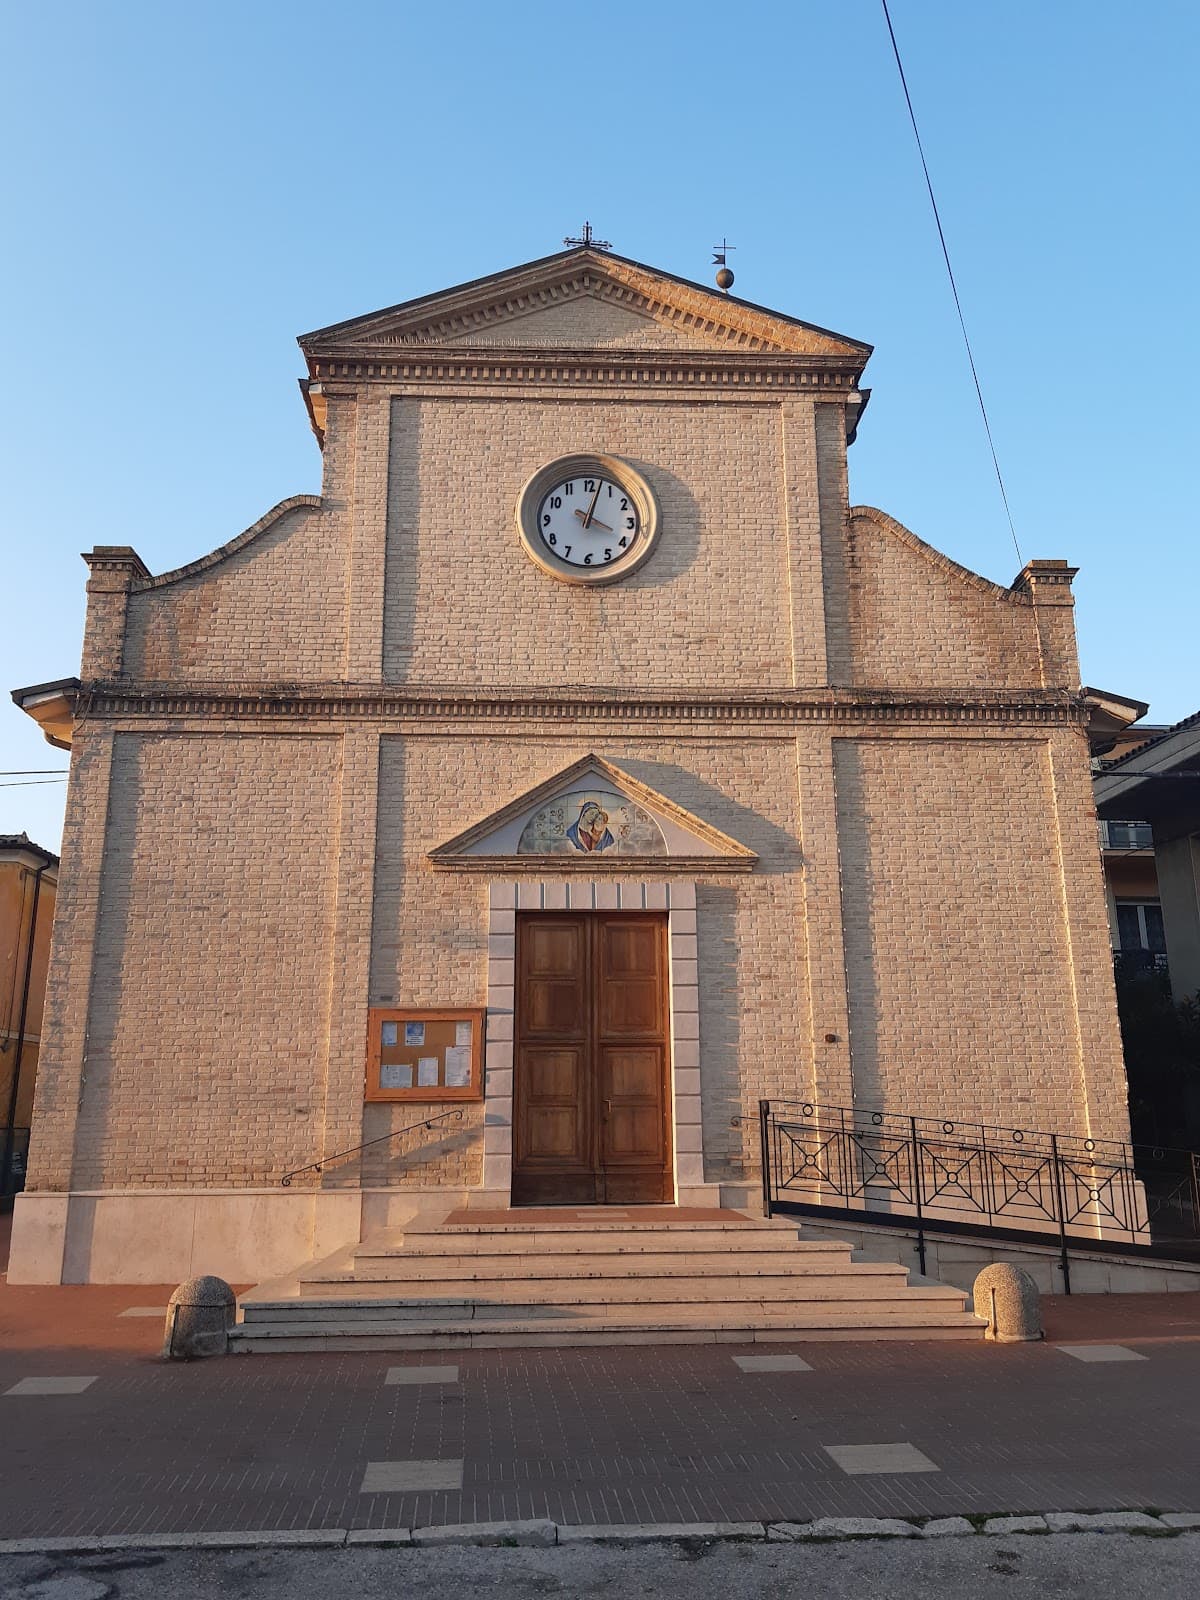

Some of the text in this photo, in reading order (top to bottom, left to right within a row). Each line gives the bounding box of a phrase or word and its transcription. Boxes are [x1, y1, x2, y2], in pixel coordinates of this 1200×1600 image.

[565, 483, 573, 495] 11
[584, 480, 595, 492] 12
[607, 486, 612, 498] 1
[551, 497, 561, 509] 10
[620, 498, 628, 511] 2
[543, 515, 551, 527] 9
[627, 517, 634, 529] 3
[549, 533, 557, 545] 8
[618, 536, 627, 548] 4
[565, 546, 572, 558] 7
[604, 549, 612, 560] 5
[584, 554, 593, 564] 6
